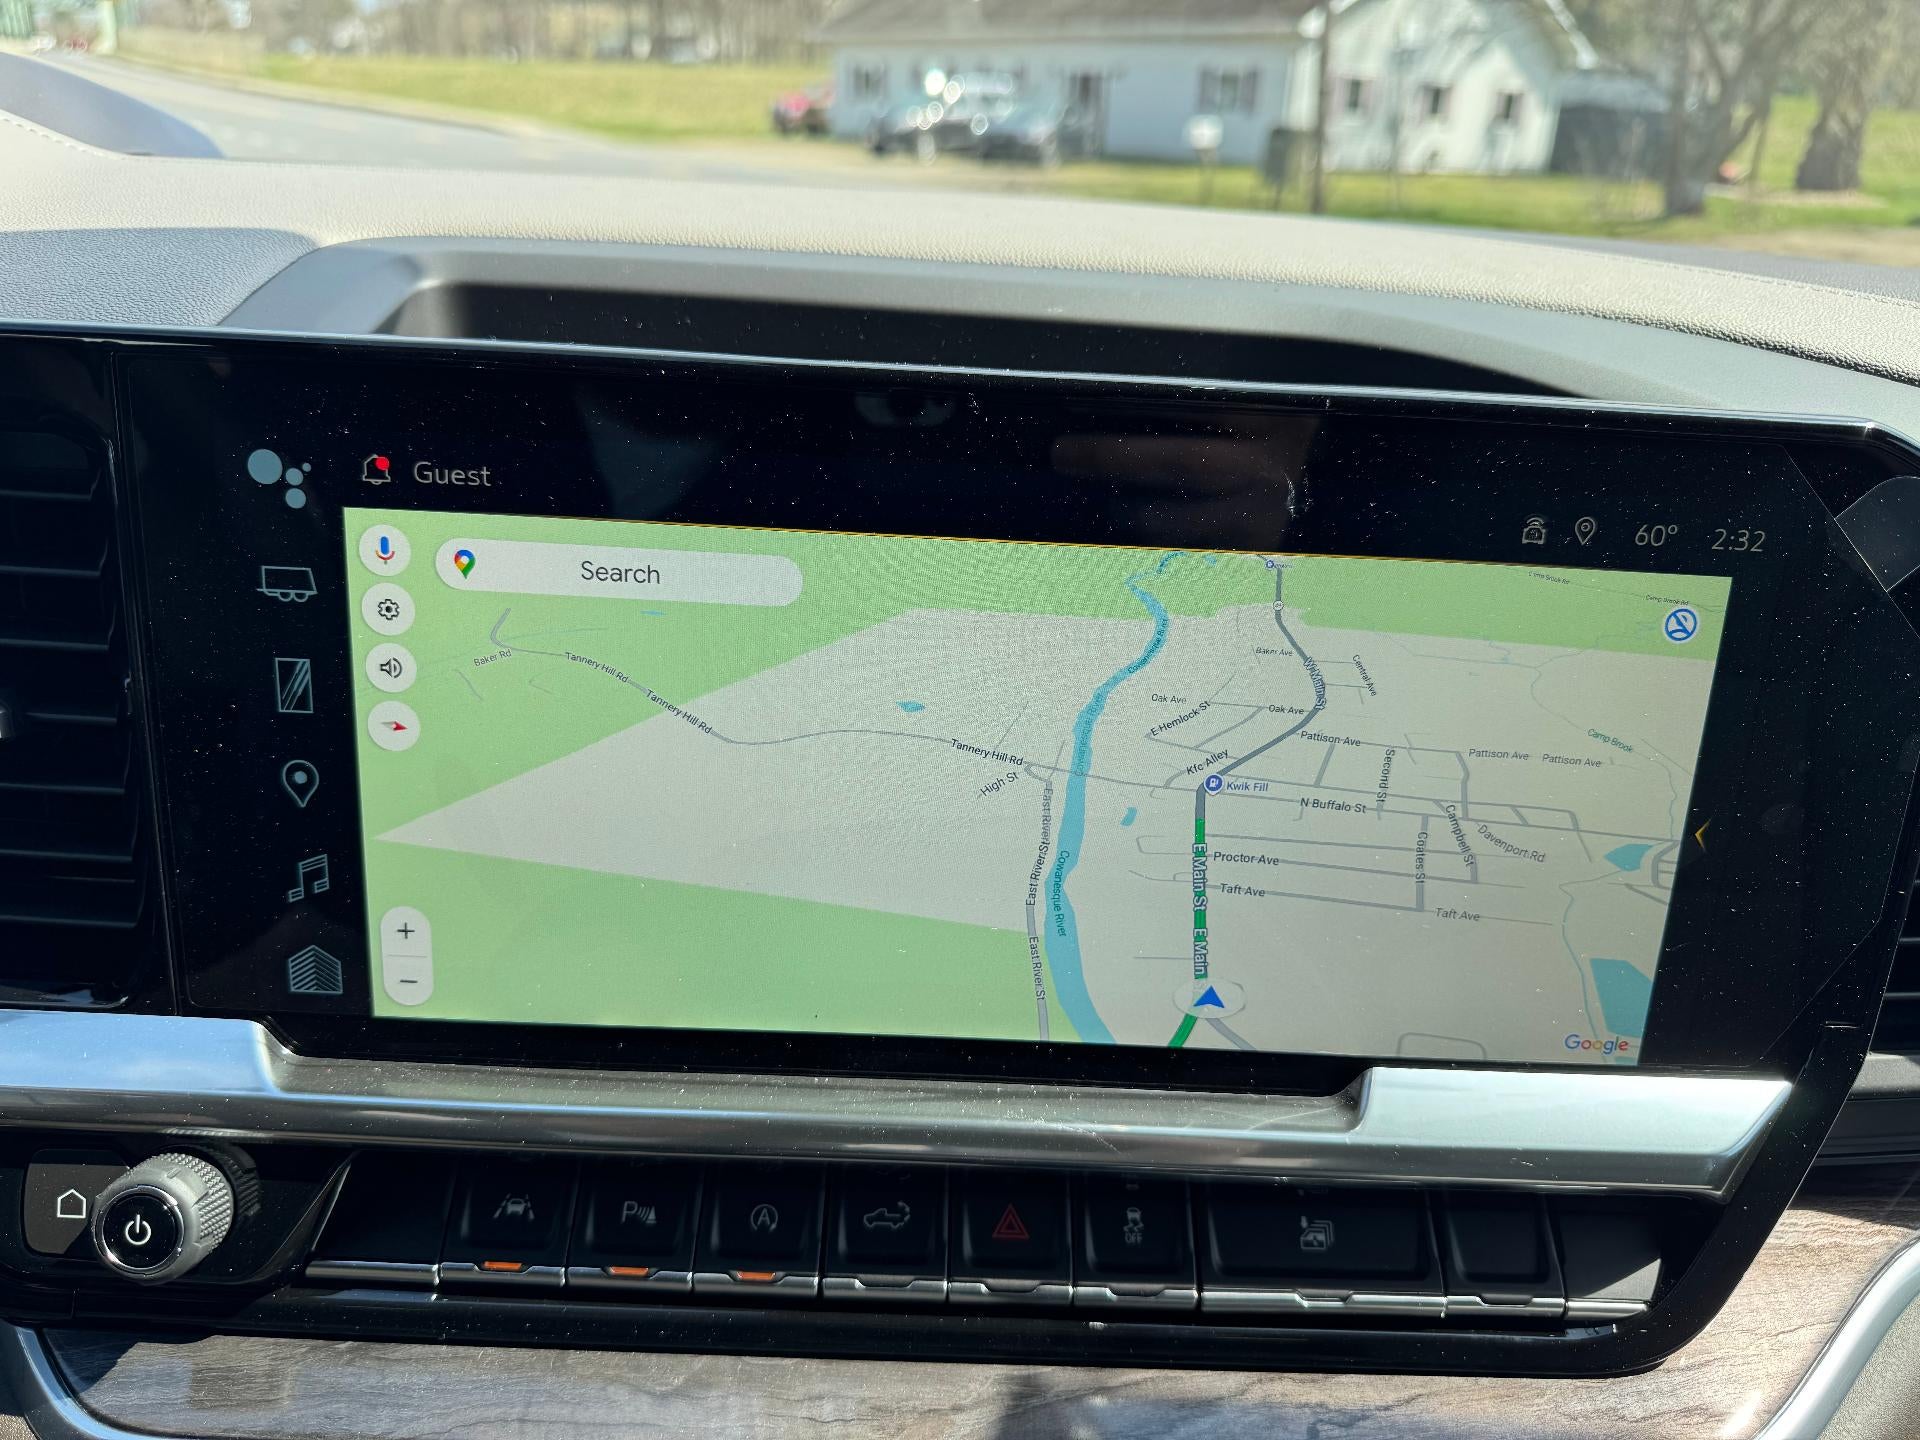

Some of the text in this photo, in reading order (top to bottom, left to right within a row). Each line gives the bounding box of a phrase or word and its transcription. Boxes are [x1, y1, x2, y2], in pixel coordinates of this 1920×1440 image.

[413, 461, 492, 487] Guest
[1635, 524, 1678, 547] 60°
[1711, 528, 1766, 552] 2:32
[580, 561, 661, 585] Search
[474, 649, 512, 667] Baker Rd
[1279, 648, 1293, 657] Ave
[565, 652, 629, 683] Tannery Hill Rd
[1352, 654, 1377, 697] Central Ave
[1151, 693, 1187, 704] Oak Ave
[1268, 704, 1305, 715] Oak Ave
[646, 689, 713, 734] Tannery Hill Rd
[1150, 700, 1211, 737] E Hemlock St
[1300, 730, 1361, 747] Pattison Ave
[1587, 728, 1633, 753] Camp Brook
[952, 738, 1024, 766] Tannery Hill Rd
[1186, 749, 1229, 775] Kfc Alley
[1468, 748, 1529, 761] Pattison Ave
[1542, 753, 1602, 768] Pattison Ave
[980, 771, 1019, 796] High St
[1226, 780, 1269, 792] Kwik Fill
[1376, 748, 1395, 802] Second St
[1042, 788, 1054, 814] East
[1300, 797, 1367, 814] N Buffalo St
[1445, 805, 1475, 867] Campbell St
[1477, 824, 1546, 863] Davenport Rd
[1213, 851, 1279, 866] Proctor Ave
[1416, 832, 1428, 883] Coates St
[1026, 841, 1050, 906] East River St
[1192, 843, 1208, 911] E Main St
[1051, 850, 1070, 936] Cowanesque River
[1220, 883, 1266, 897] Taft Ave
[1435, 907, 1481, 921] Taft Ave
[1193, 928, 1208, 976] E Main
[1029, 936, 1046, 1000] East River St
[1564, 1034, 1629, 1056] Google
[1125, 1232, 1143, 1244] OFF
